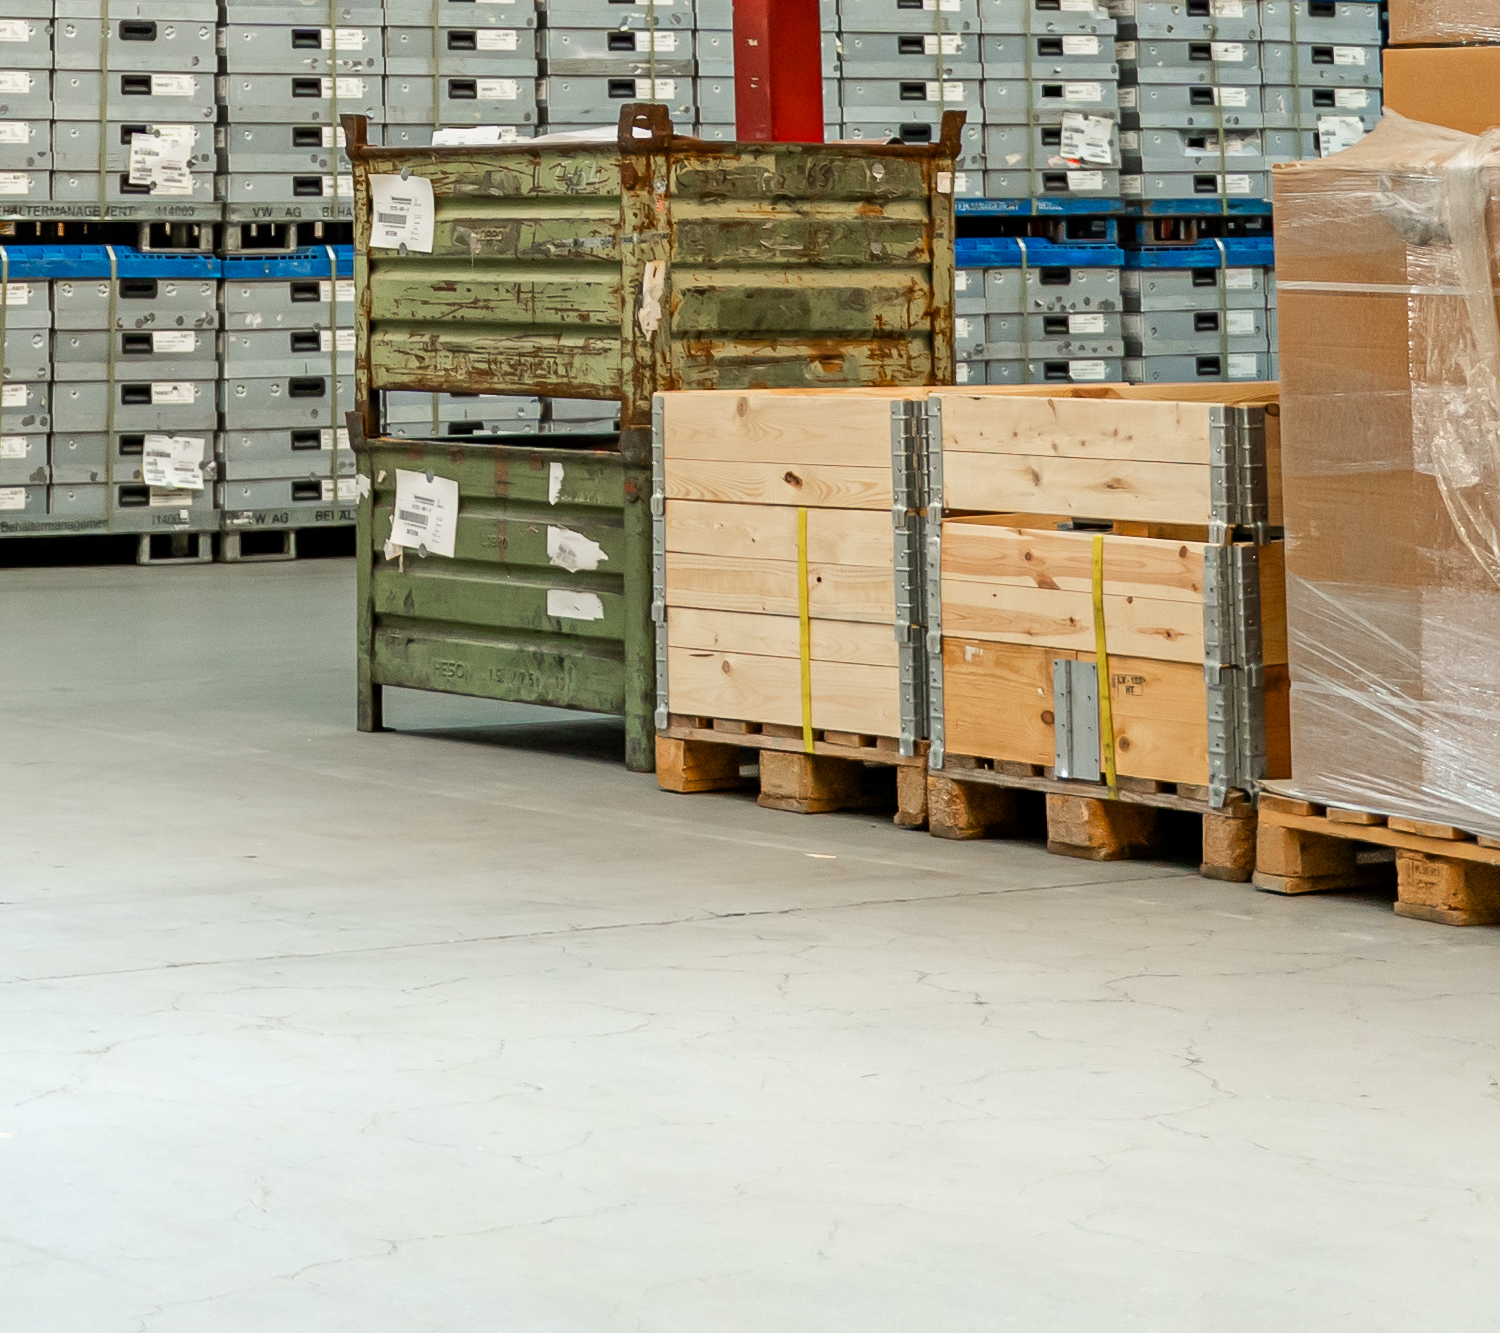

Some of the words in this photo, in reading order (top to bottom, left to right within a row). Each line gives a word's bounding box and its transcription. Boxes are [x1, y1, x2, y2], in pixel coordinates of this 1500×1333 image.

[252, 207, 273, 218] VW
[285, 207, 302, 218] AG
[272, 512, 289, 523] AG
